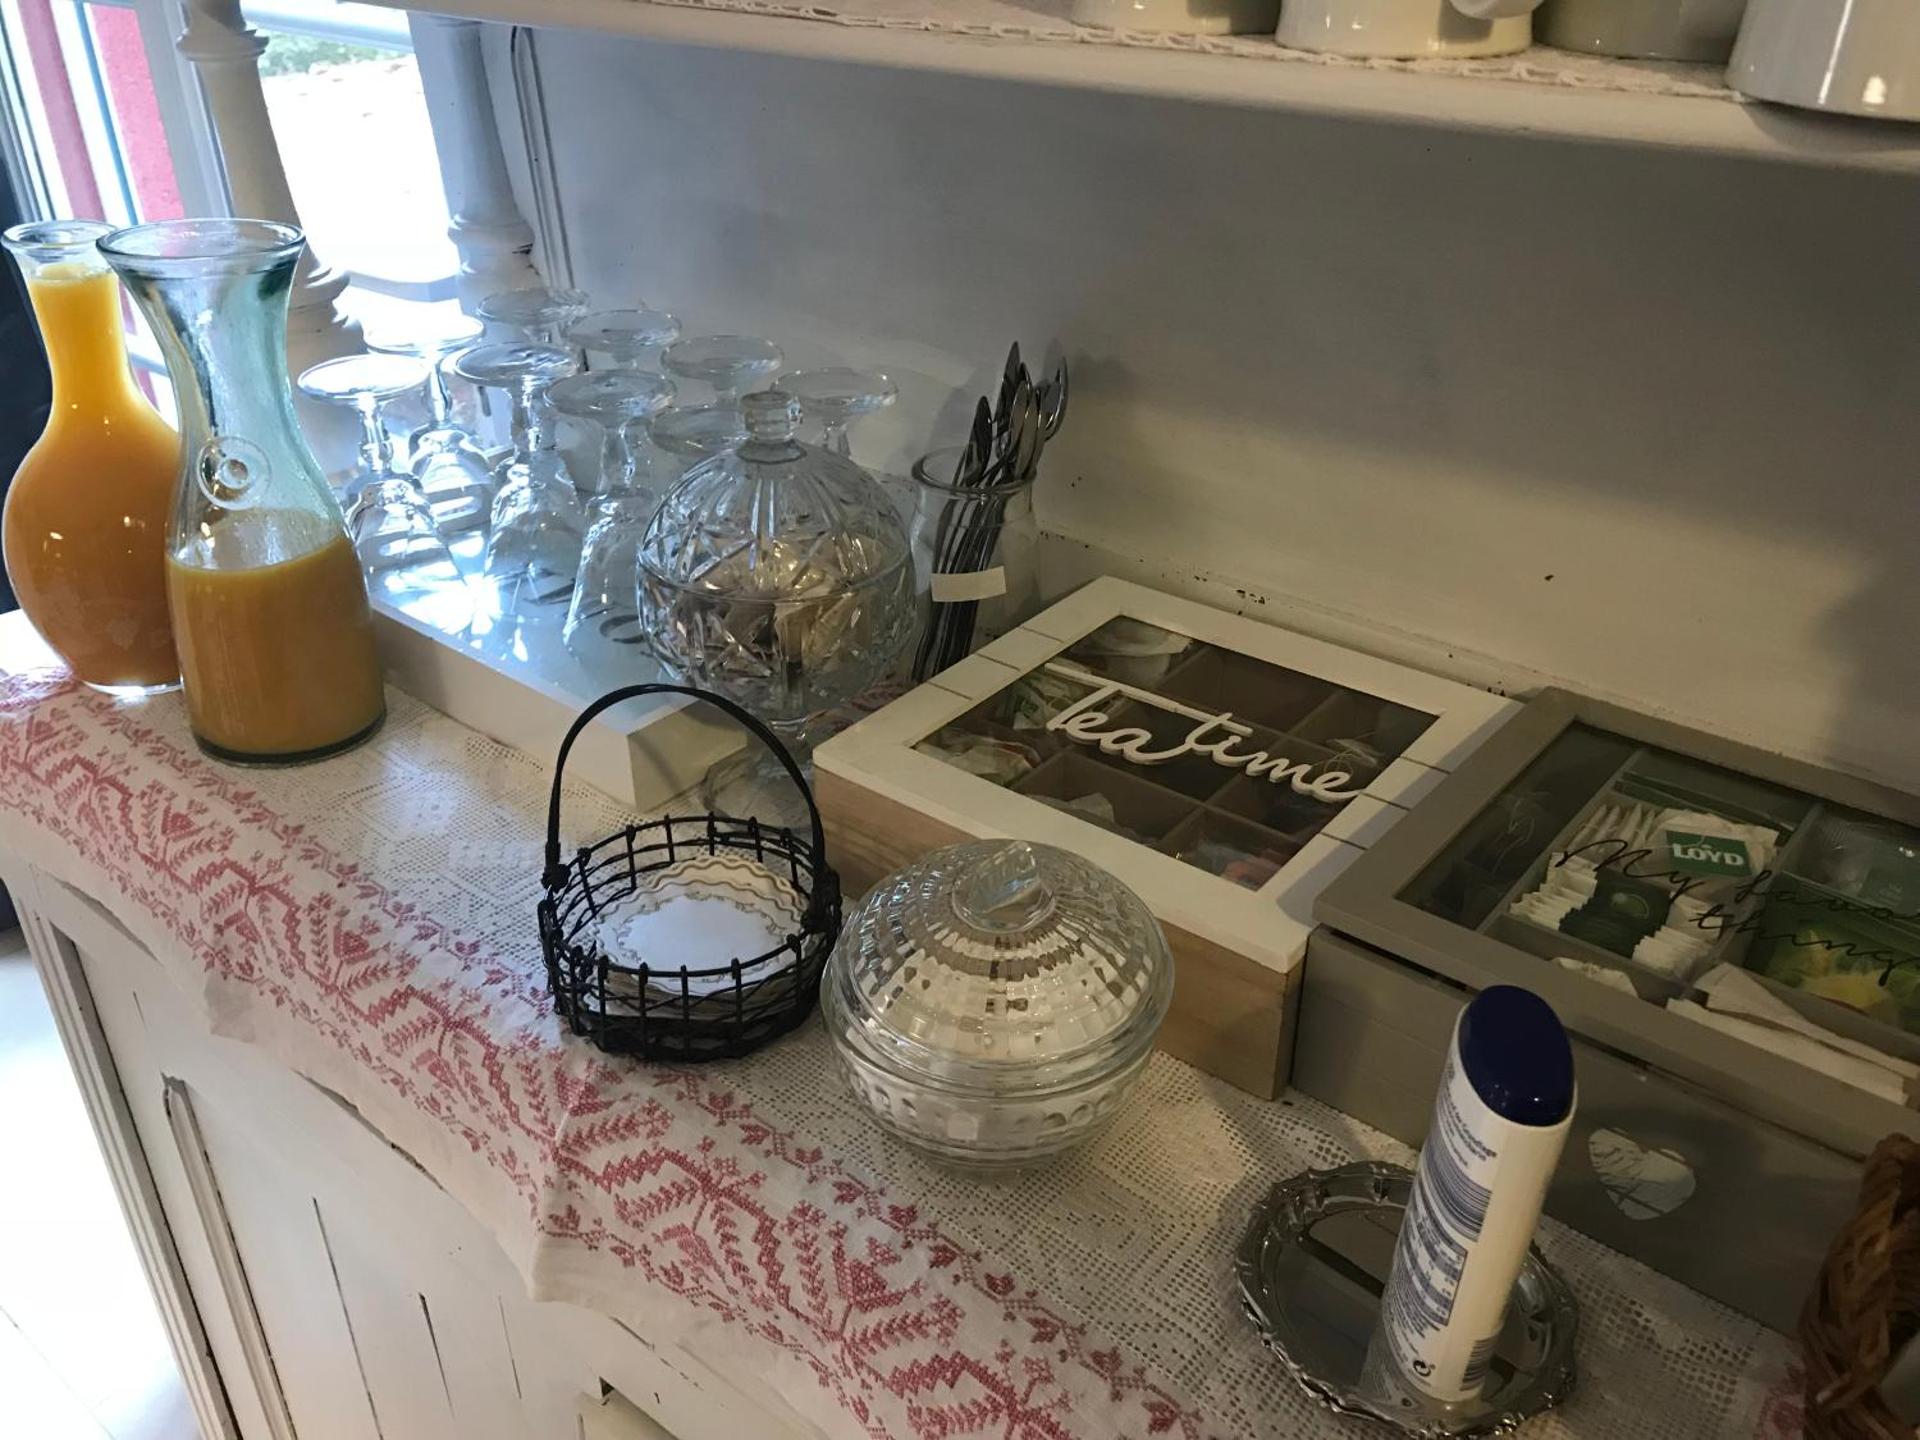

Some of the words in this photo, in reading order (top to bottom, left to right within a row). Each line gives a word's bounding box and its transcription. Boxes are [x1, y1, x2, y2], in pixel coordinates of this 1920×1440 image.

[1182, 711, 1364, 802] time
[1554, 838, 1704, 905] My
[1672, 842, 1744, 866] LOYD
[1688, 903, 1920, 986] thing
